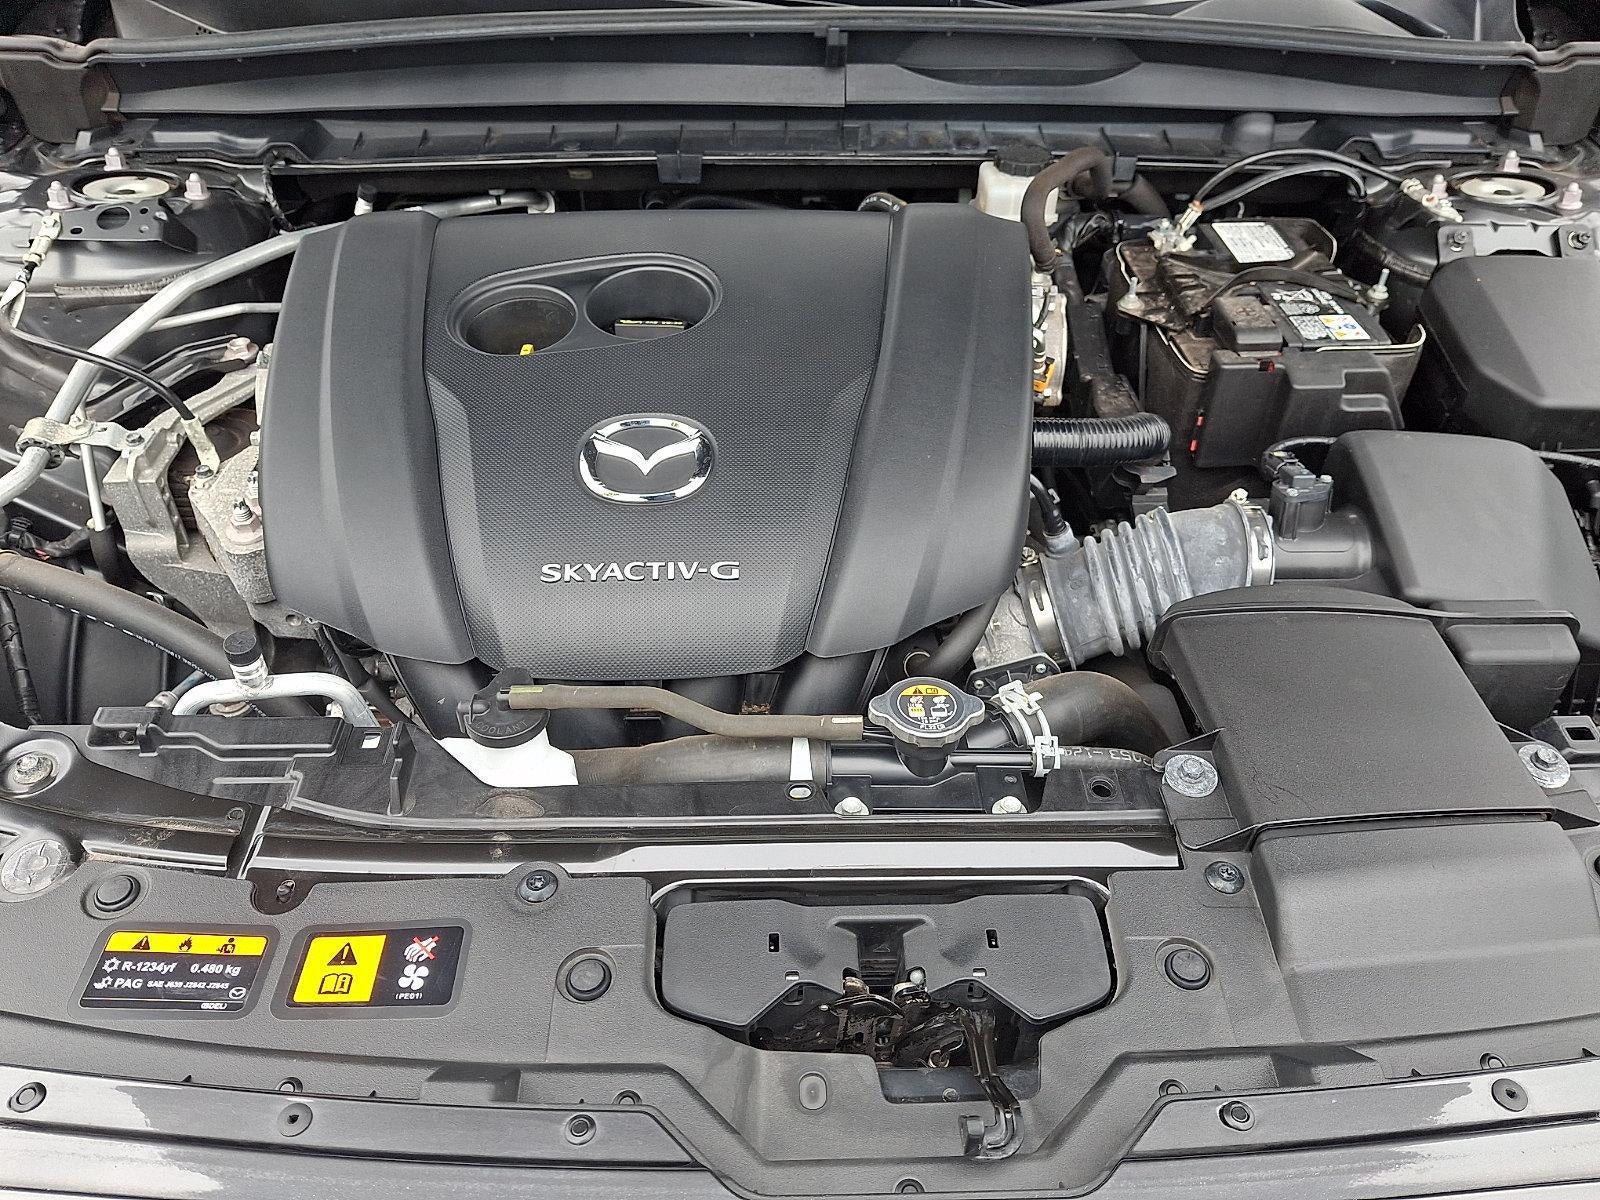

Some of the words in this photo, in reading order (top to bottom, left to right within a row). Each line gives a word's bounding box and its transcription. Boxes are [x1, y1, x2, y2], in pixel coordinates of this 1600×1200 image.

[540, 561, 740, 582] SKYACTIV-G
[475, 720, 529, 735] COOLANT
[121, 961, 177, 974] R-1234yf
[190, 963, 223, 974] 0.480
[225, 964, 242, 976] kg
[114, 978, 143, 989] PAG
[147, 980, 164, 988] SAE
